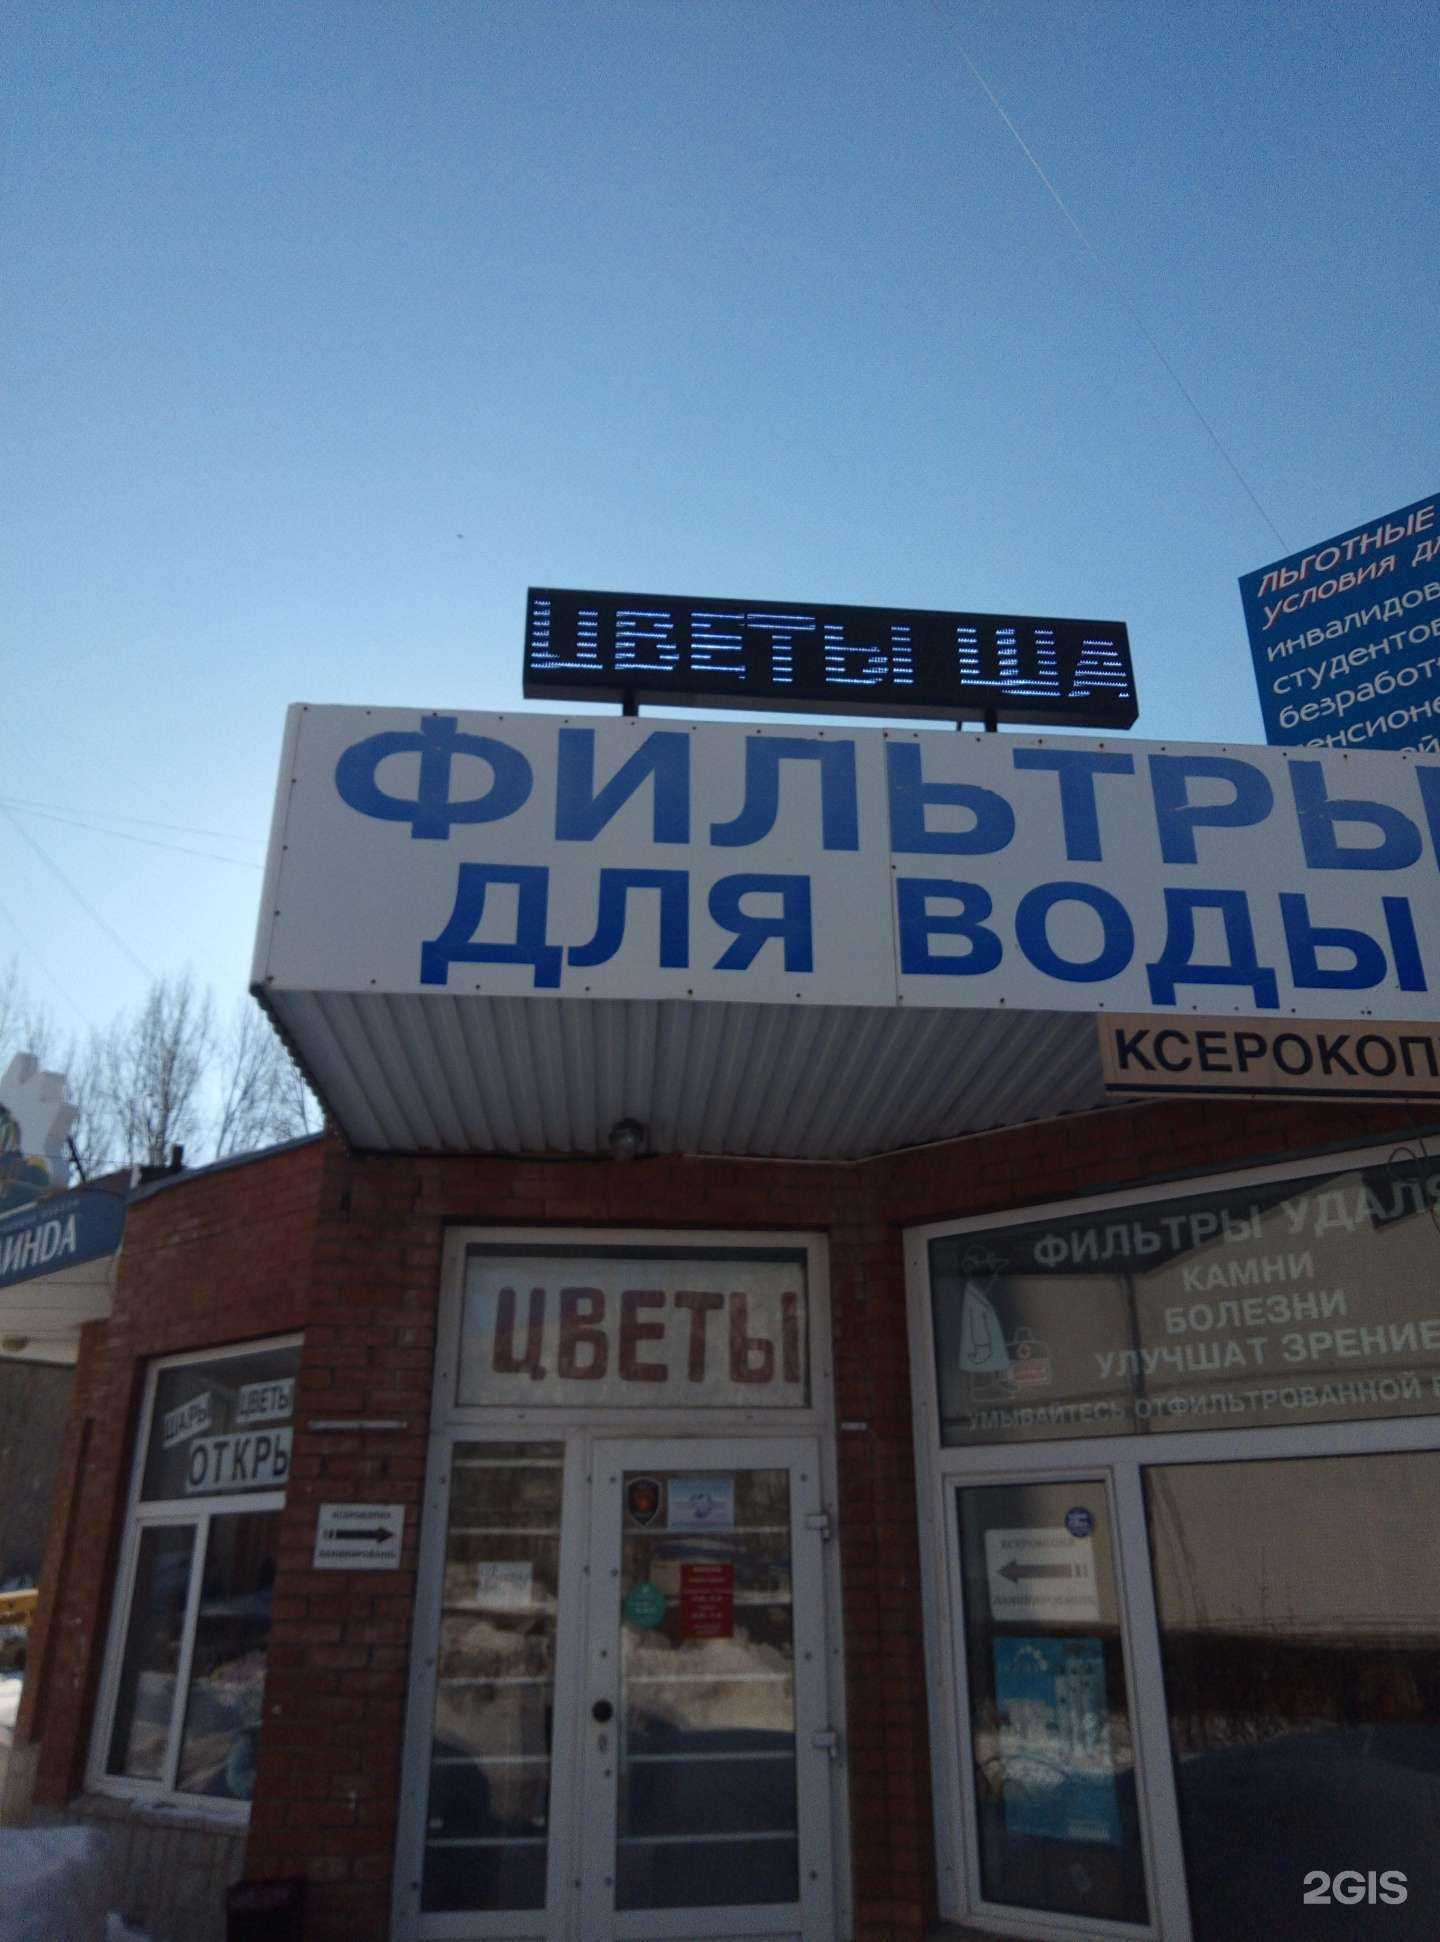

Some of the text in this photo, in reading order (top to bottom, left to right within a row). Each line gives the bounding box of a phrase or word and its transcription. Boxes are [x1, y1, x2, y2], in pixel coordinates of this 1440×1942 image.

[1257, 505, 1435, 598] ЛЬГОТНЫЕ
[1279, 657, 1440, 729] безработ
[334, 715, 1440, 873] ФИЛЬТРЫ
[420, 862, 1428, 1009] ДЛЯ ВОДЫ
[1114, 1028, 1440, 1078] КСЕРОКОП
[1033, 1202, 1265, 1269] ФИЛЬТРЫ
[1181, 1250, 1315, 1293] КАМНИ
[491, 1286, 802, 1385] ЦВЕТЫ
[1165, 1289, 1348, 1335] БОЛЕЗНИ
[1095, 1318, 1440, 1380] УЛУЧШАТ ЗРЕНИЕ
